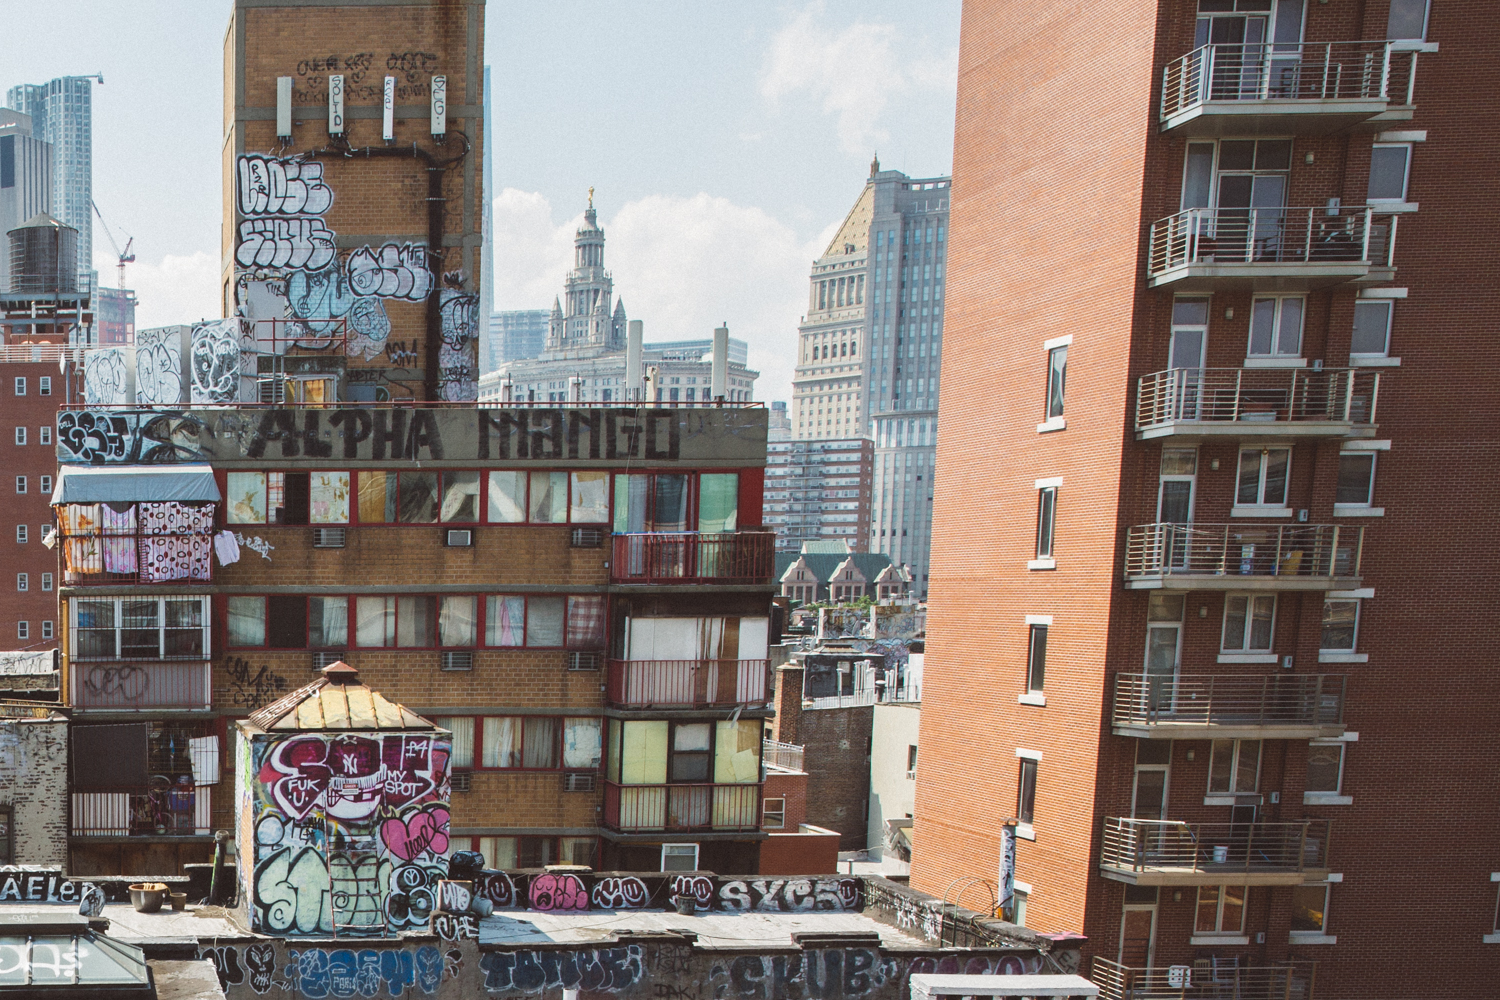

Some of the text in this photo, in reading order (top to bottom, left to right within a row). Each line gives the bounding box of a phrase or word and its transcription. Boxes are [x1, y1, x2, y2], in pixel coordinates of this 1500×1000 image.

[247, 408, 445, 460] ALPHA
[387, 769, 407, 780] MY
[288, 778, 321, 793] FUK
[385, 780, 424, 796] SPOT
